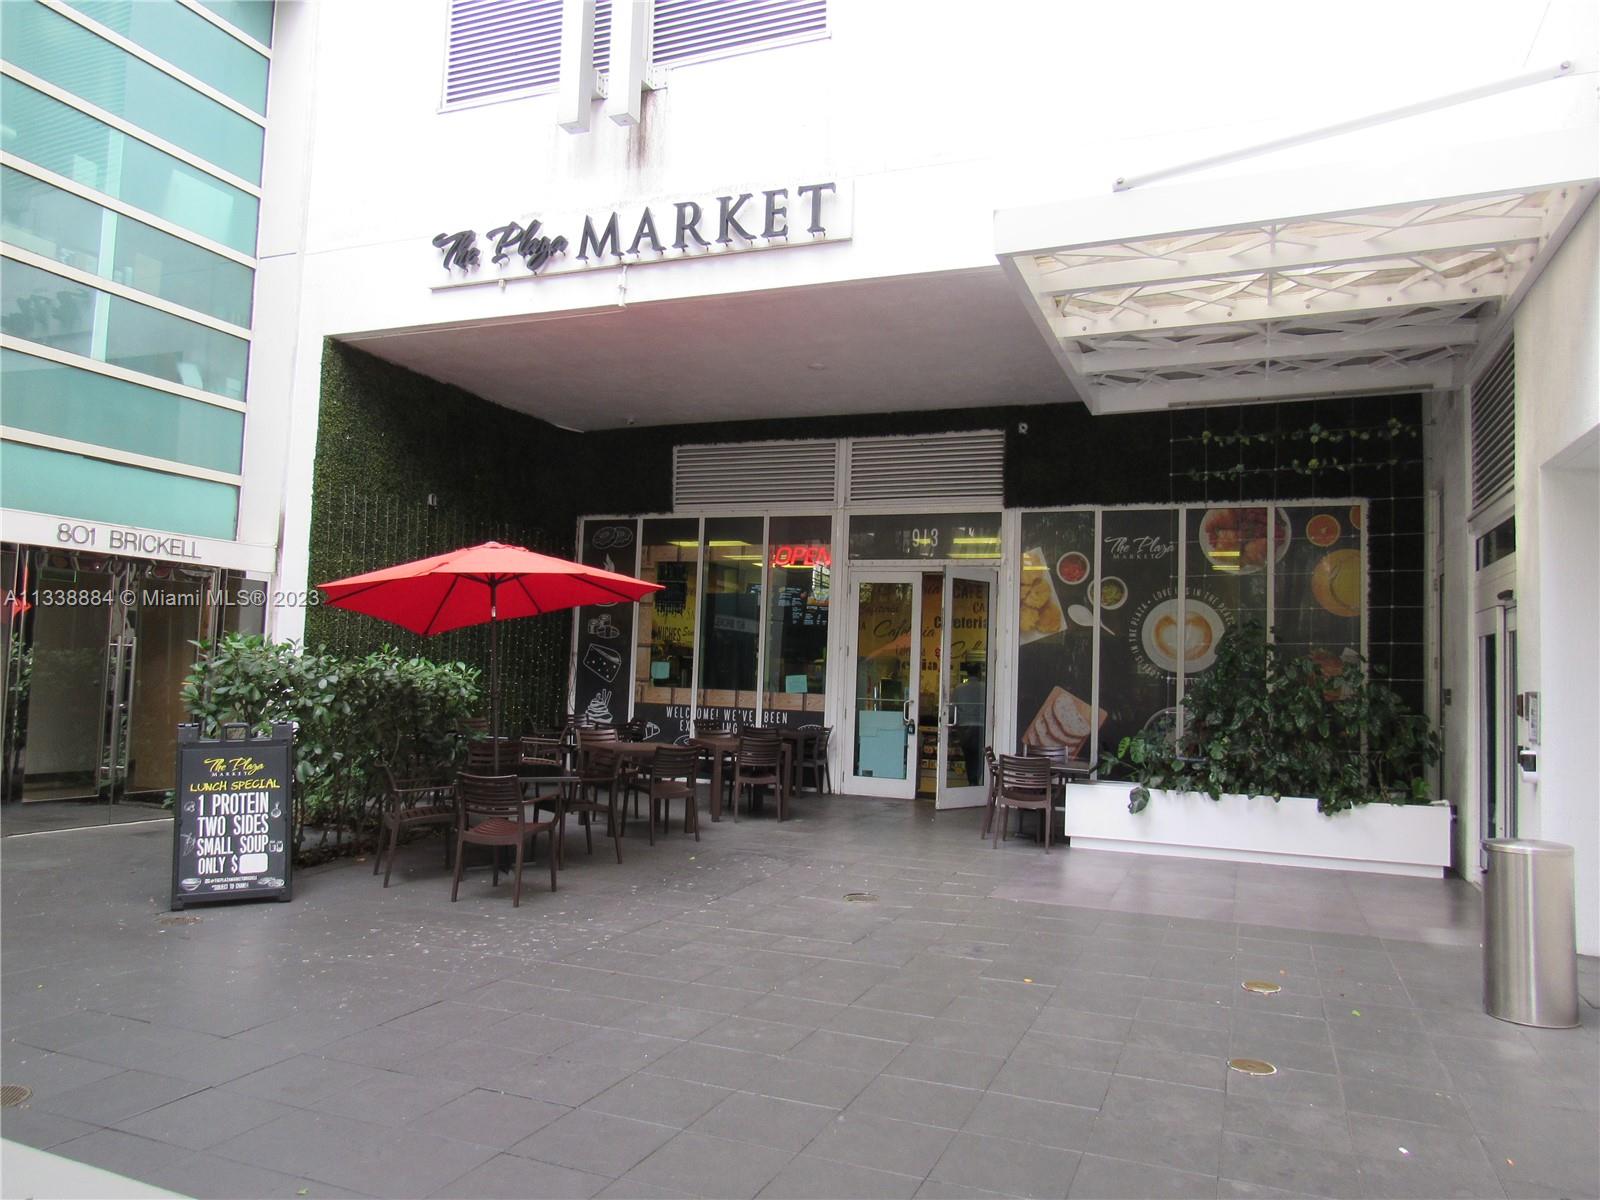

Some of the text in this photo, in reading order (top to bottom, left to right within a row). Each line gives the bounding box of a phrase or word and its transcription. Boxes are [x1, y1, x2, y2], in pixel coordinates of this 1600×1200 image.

[432, 182, 836, 275] The Plaza MARKET
[57, 523, 202, 559] 801 BRICKELL
[912, 528, 939, 547] 913
[1104, 536, 1130, 554] The
[775, 546, 832, 566] OPEN
[666, 706, 788, 725] WELCOME! WE'VE BEEN
[204, 757, 265, 776] The Plaza
[190, 778, 280, 792] LUNCH SPECIAL
[198, 792, 269, 816] 1 PROTEIN
[197, 814, 269, 837] TWO SIDES
[197, 835, 269, 857] SMALL SOUP
[198, 856, 226, 875] ONLY
